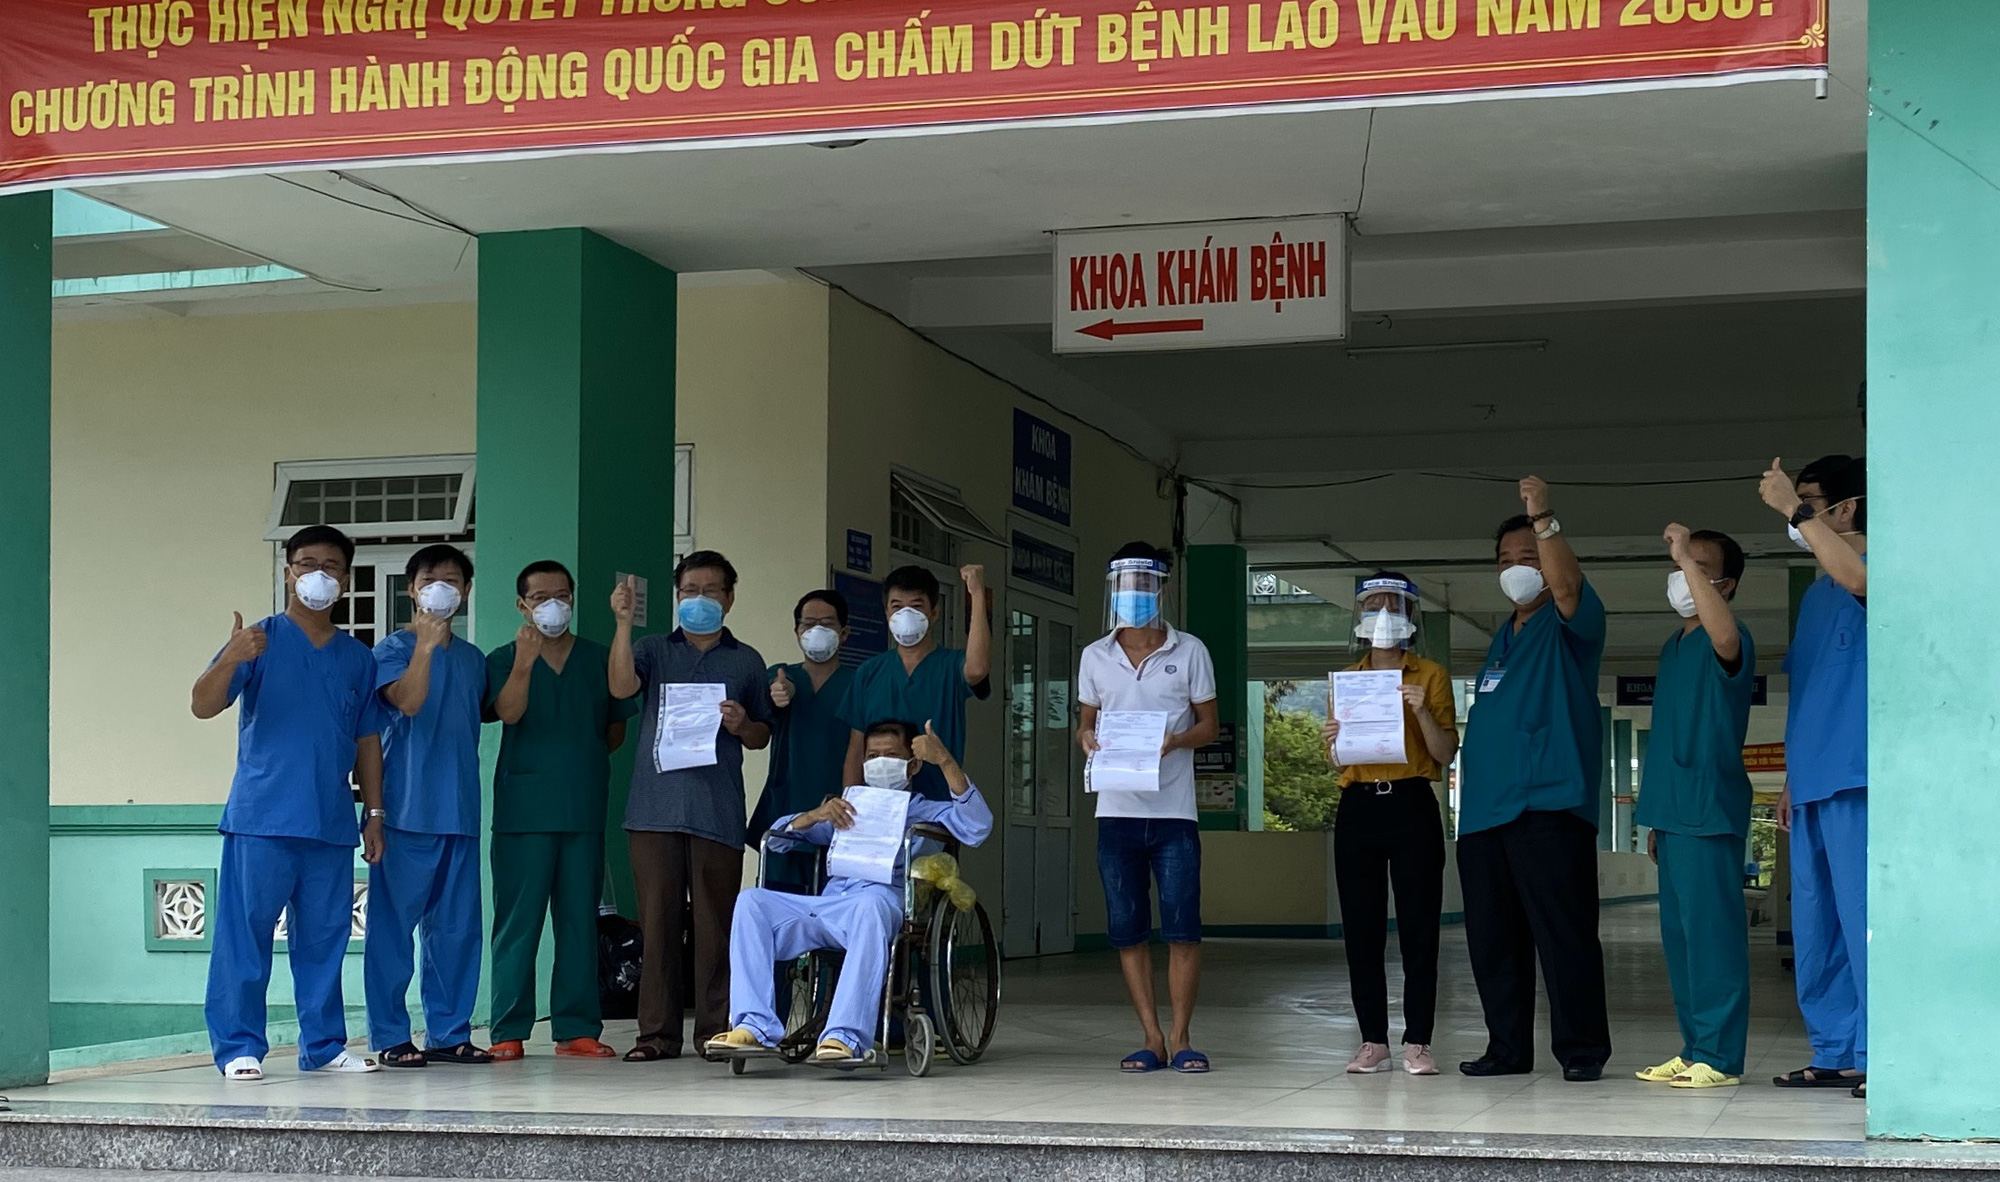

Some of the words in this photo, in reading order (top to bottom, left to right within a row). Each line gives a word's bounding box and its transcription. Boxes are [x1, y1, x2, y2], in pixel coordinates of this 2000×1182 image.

[88, 0, 194, 58] THỰC
[10, 79, 175, 137] CHƯƠNG
[189, 64, 315, 122] TRÌNH
[330, 55, 450, 113] HÀNH
[464, 46, 588, 113] ĐỘNG
[603, 26, 726, 101] QUỐC
[741, 36, 819, 87] GIA
[834, 10, 974, 81] CHẤM
[990, 8, 1082, 70] DỨT
[1097, 0, 1230, 72] BỆNH
[1247, 0, 1339, 53] LAO
[1070, 252, 1147, 311] KHOA
[1157, 235, 1238, 306] KHÁM
[1250, 231, 1326, 313] BỆNH
[1032, 424, 1056, 461] KHOA
[1015, 466, 1044, 503] KHÁM
[1046, 476, 1070, 514] BỆNH
